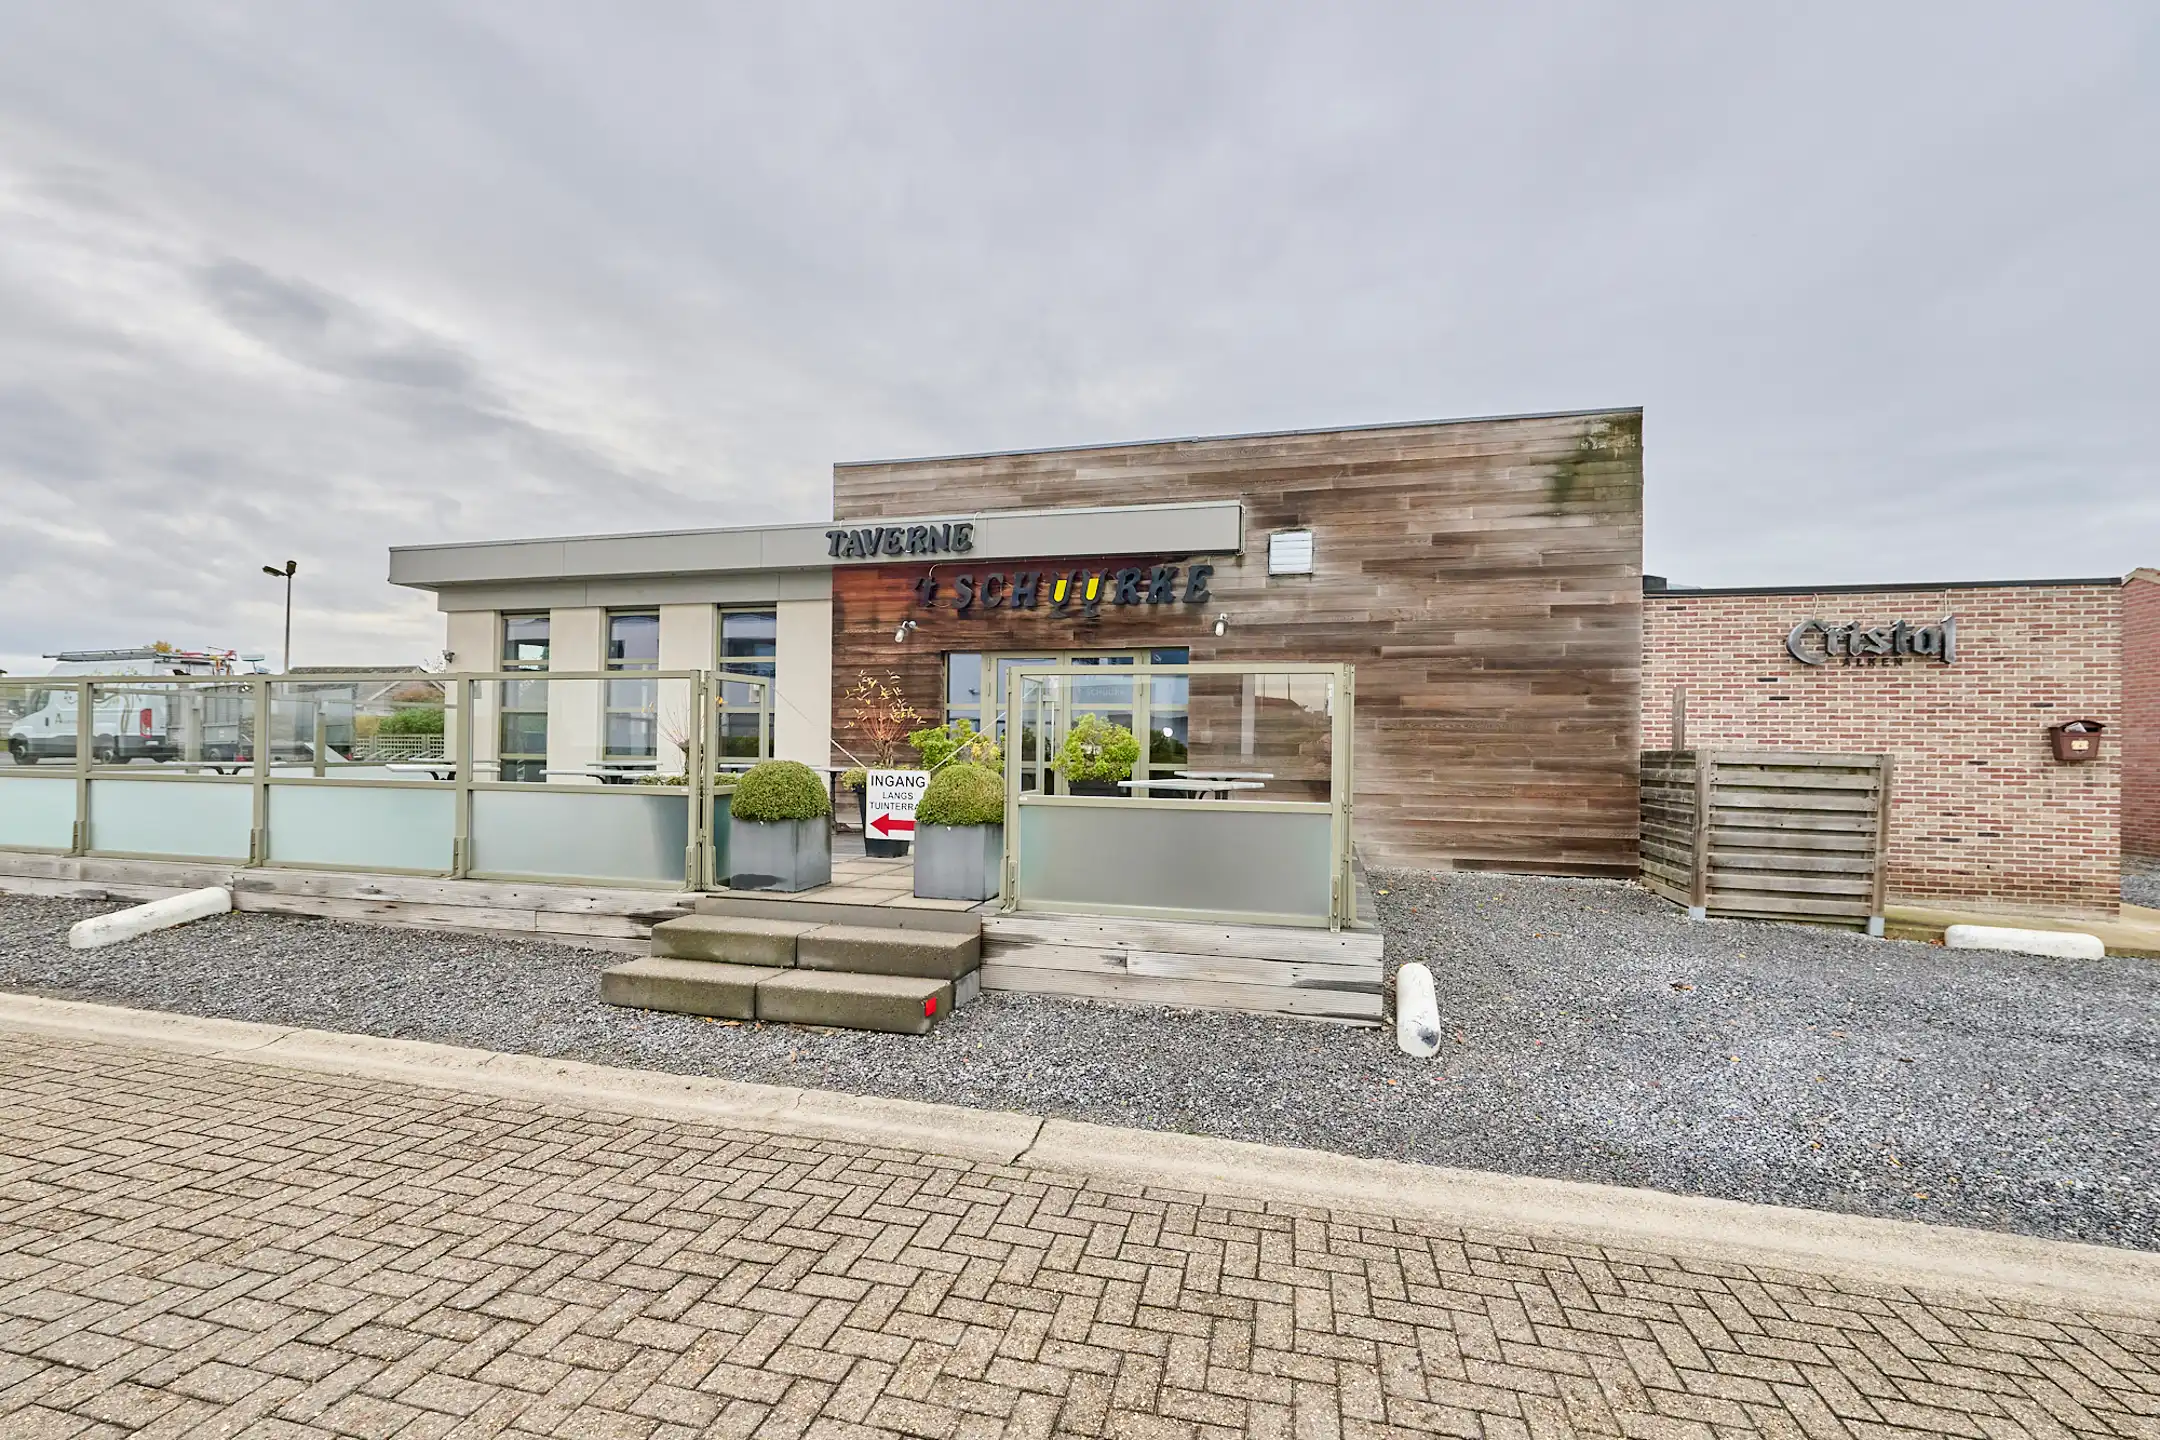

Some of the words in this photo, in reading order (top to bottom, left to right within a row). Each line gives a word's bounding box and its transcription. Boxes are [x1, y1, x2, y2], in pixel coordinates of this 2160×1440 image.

[825, 523, 974, 557] TAVERNE
[952, 564, 1214, 619] SCHUURKE
[1842, 657, 1903, 667] ALKEN
[871, 775, 926, 788] INGANG
[882, 792, 914, 800] LANGS
